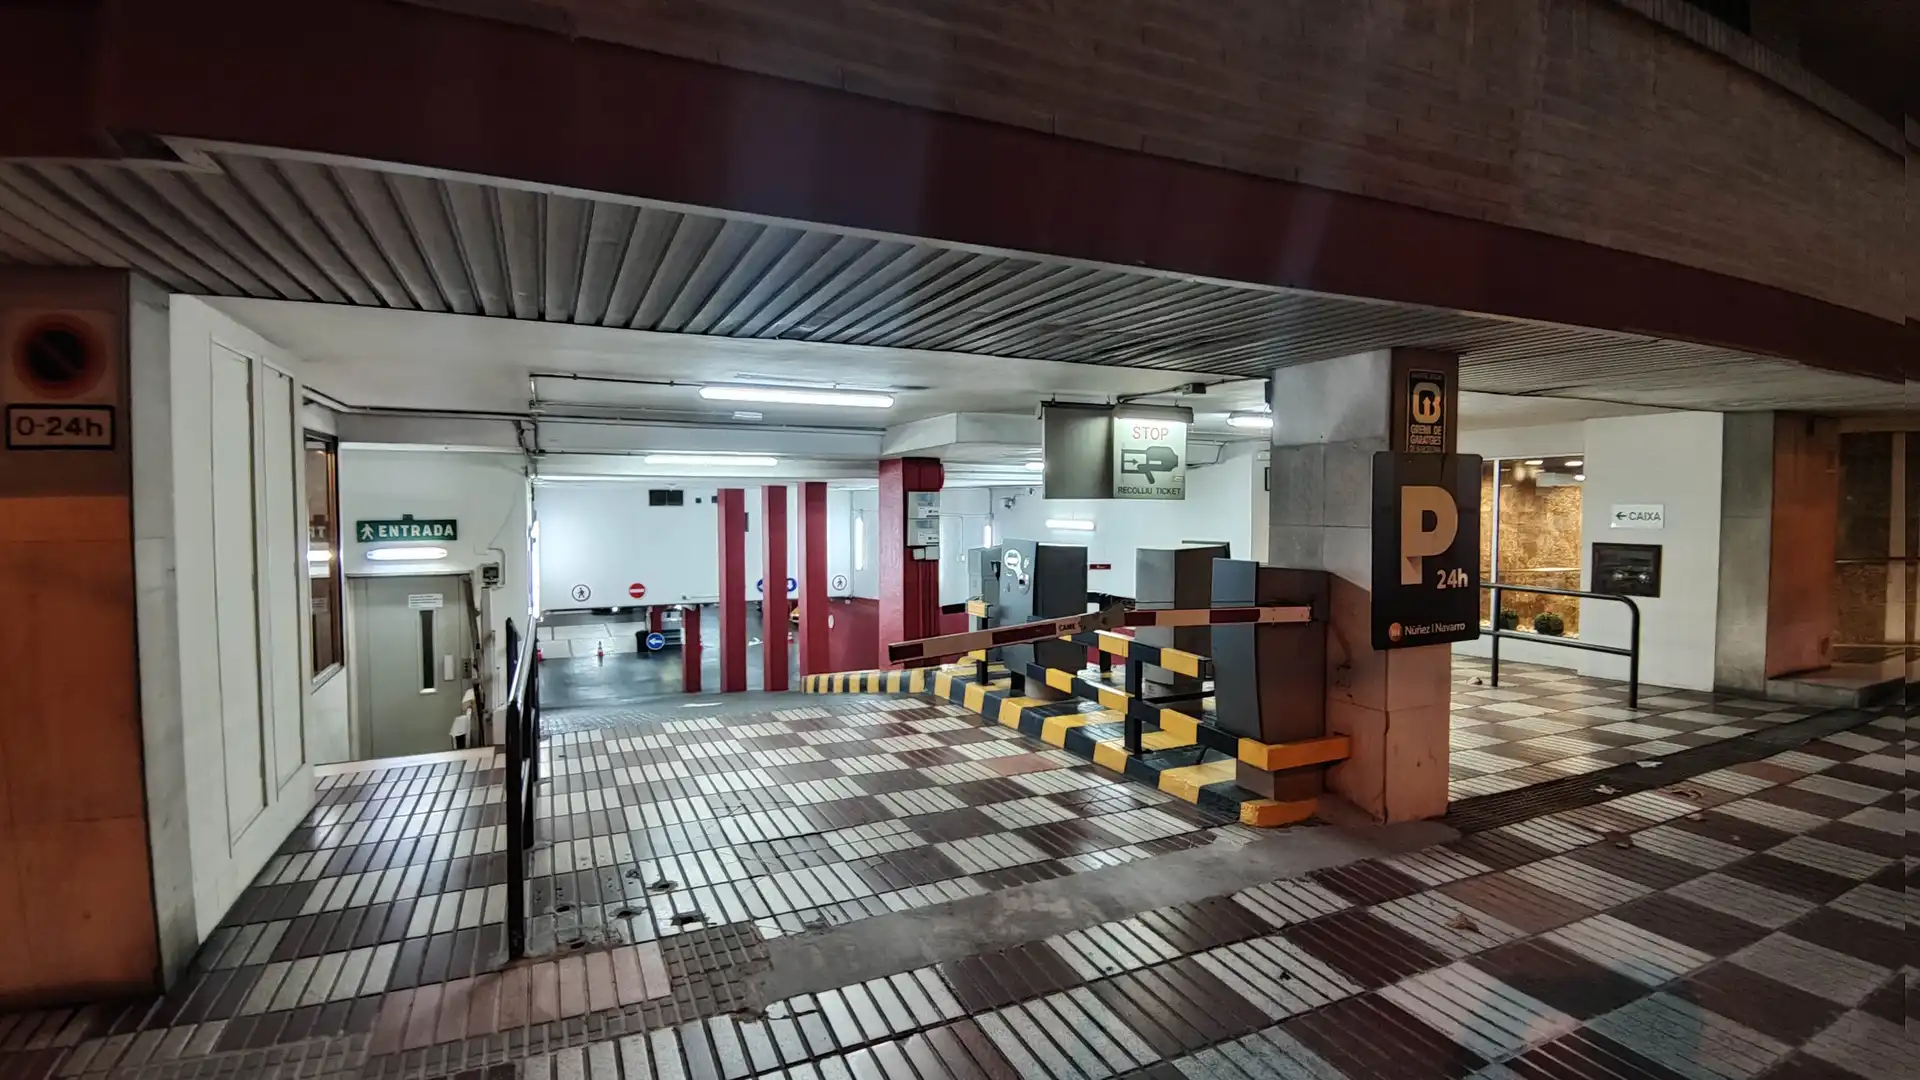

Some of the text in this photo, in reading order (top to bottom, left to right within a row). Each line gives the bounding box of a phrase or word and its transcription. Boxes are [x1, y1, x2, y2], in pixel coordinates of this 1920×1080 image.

[16, 416, 104, 437] 0-24h
[1132, 425, 1169, 440] STOP
[1117, 486, 1182, 496] RECOLLIU TICKET
[1628, 511, 1662, 521] CAIXA
[378, 524, 454, 538] ENTRADA
[1401, 485, 1458, 585] P
[1436, 567, 1469, 590] 24h
[1404, 624, 1431, 636] Núñez
[1435, 622, 1466, 633] Navarro
